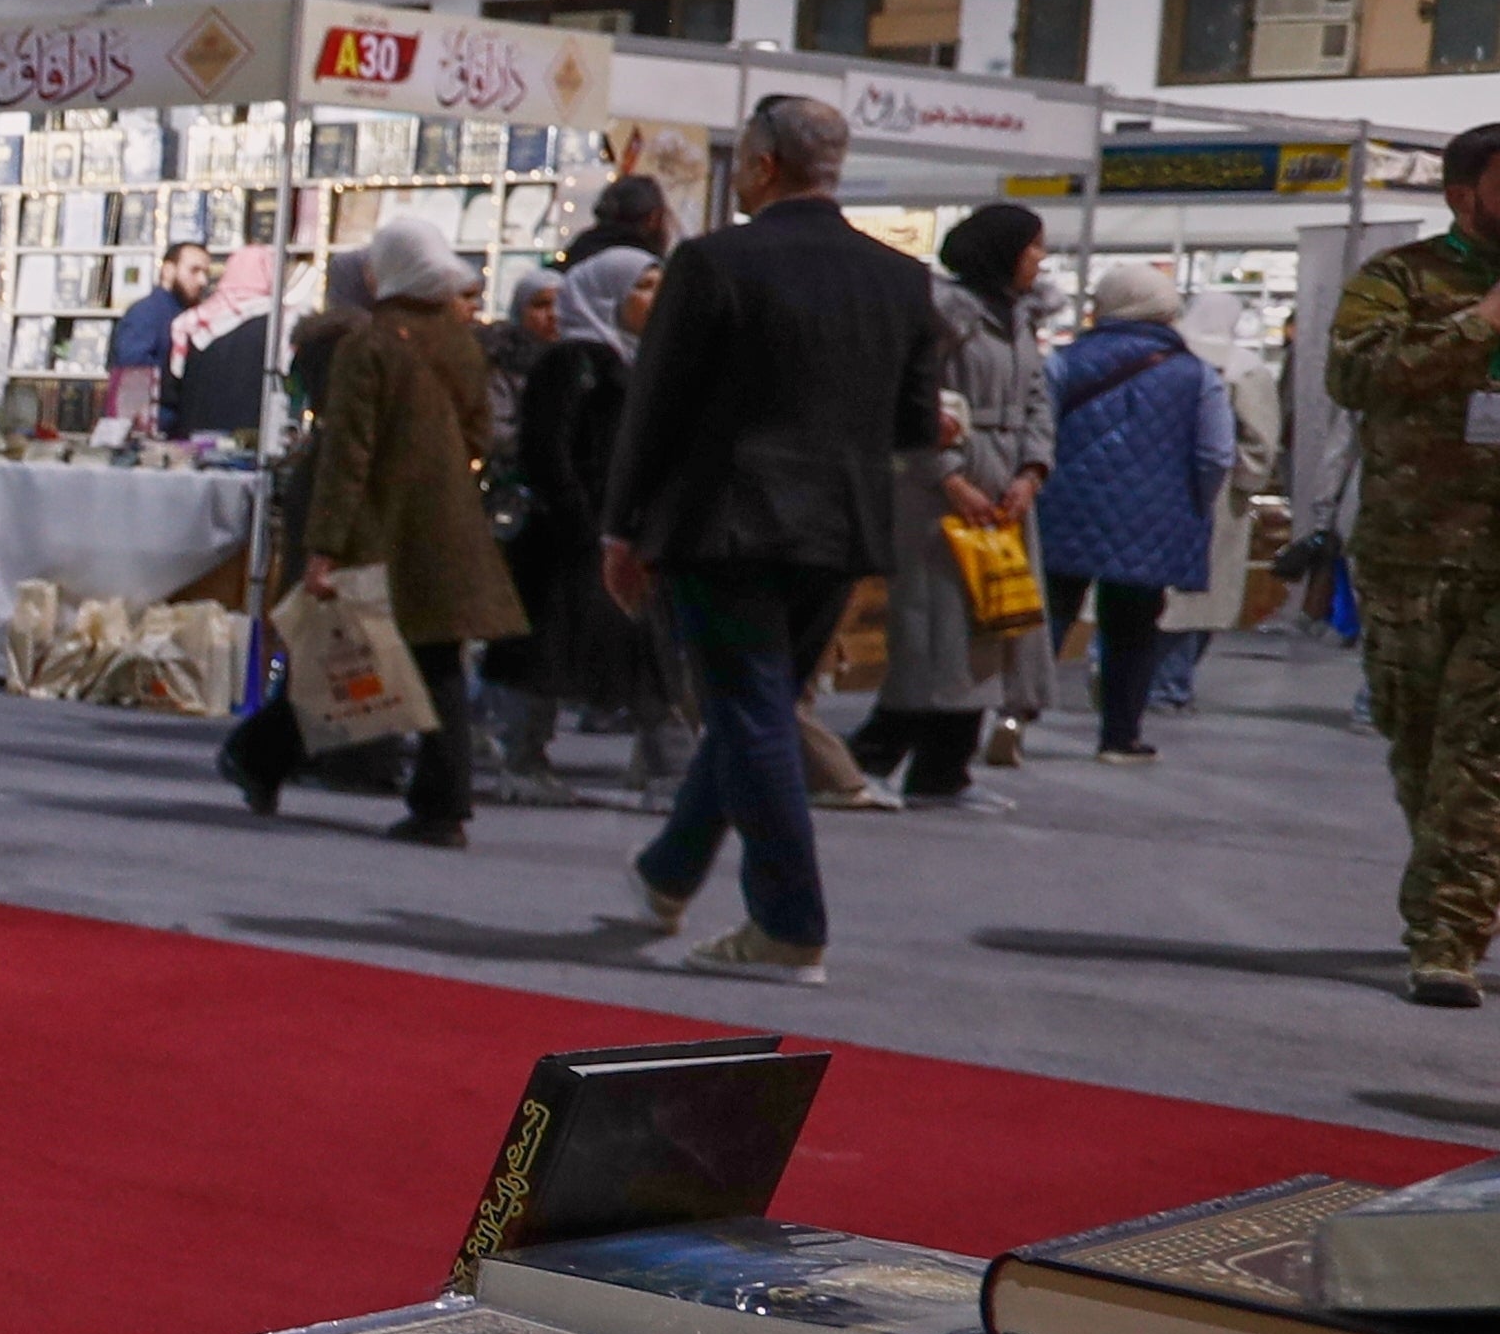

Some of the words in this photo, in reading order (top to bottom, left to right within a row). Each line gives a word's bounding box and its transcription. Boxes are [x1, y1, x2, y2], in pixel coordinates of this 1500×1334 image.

[54, 30, 136, 105] دار
[334, 33, 400, 81] A30
[506, 1099, 550, 1176] تحت
